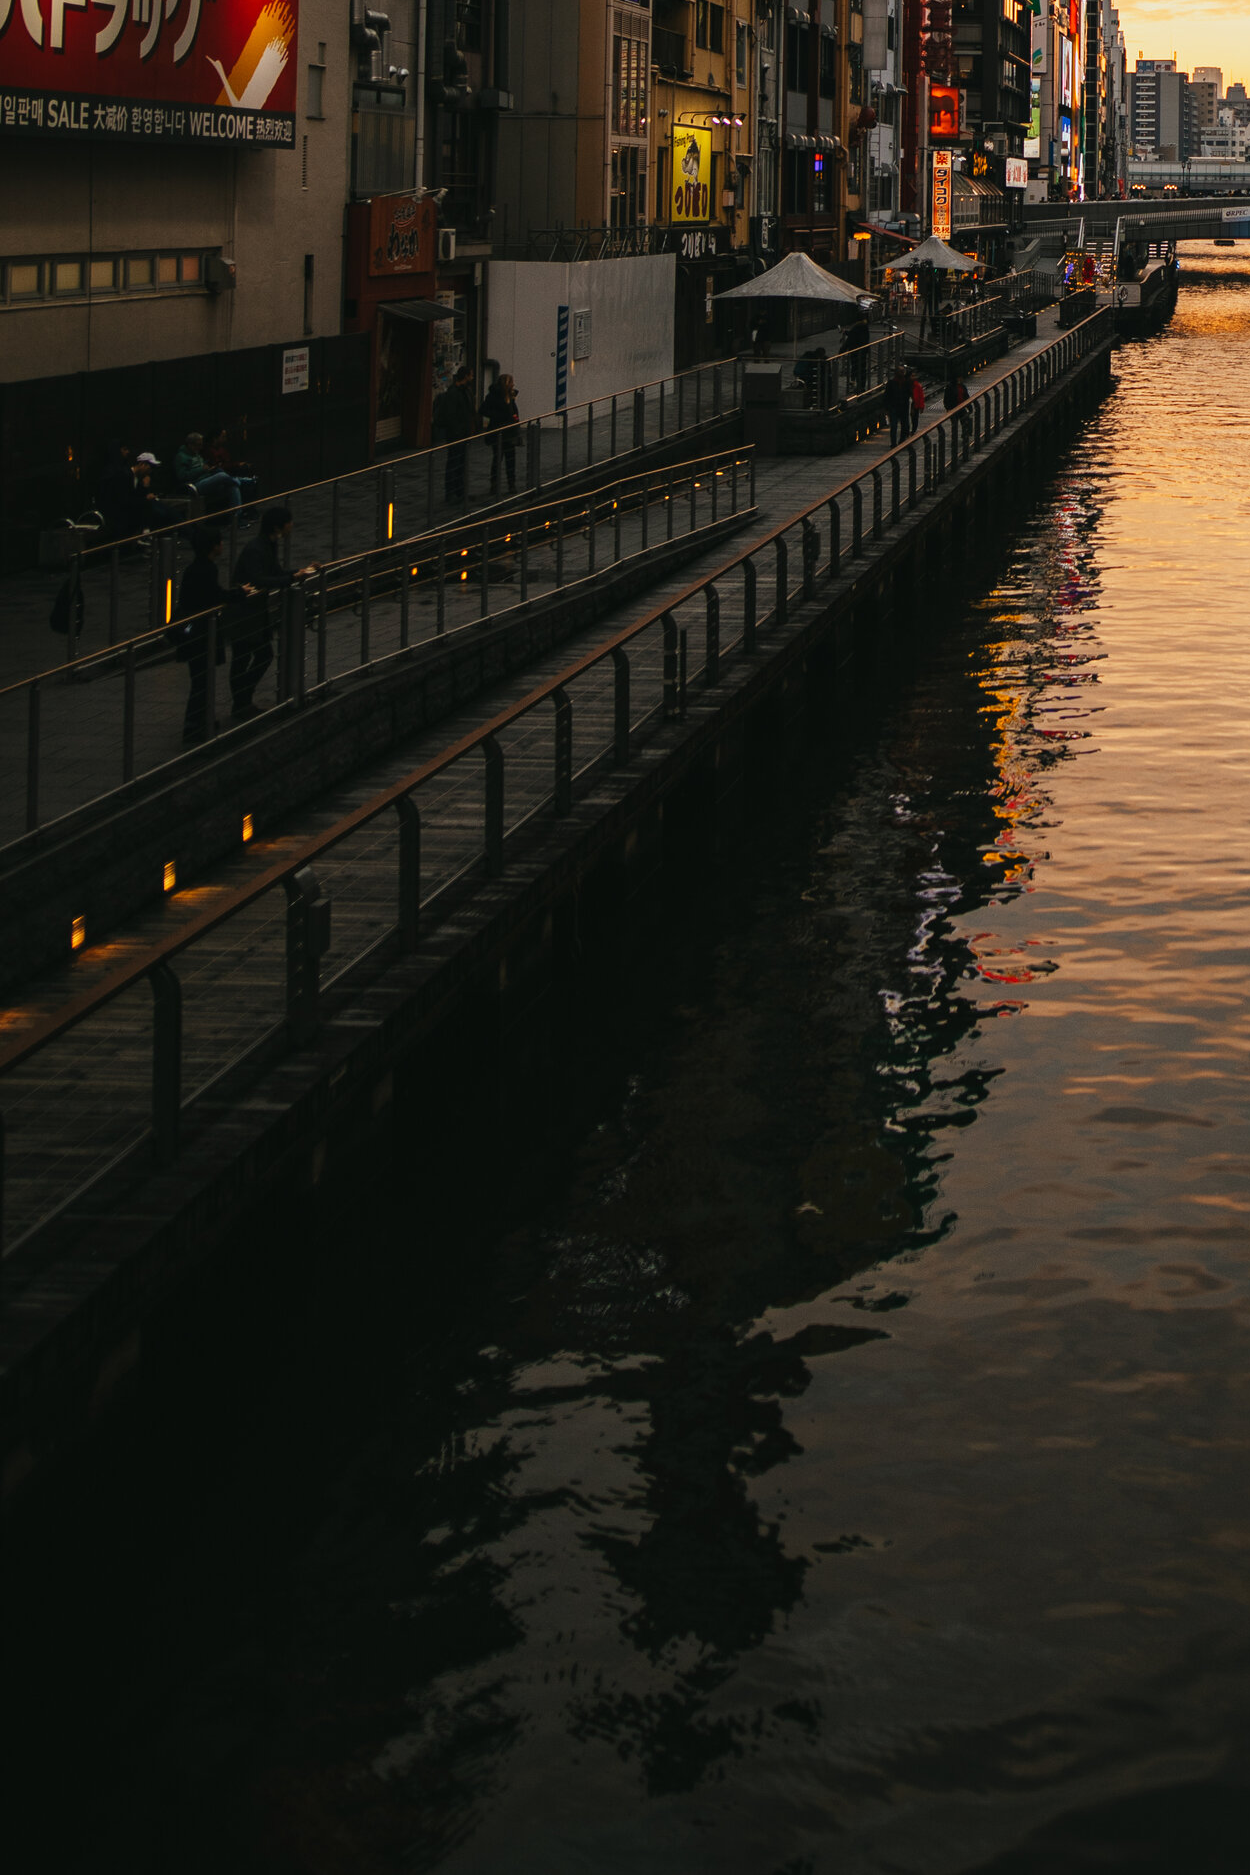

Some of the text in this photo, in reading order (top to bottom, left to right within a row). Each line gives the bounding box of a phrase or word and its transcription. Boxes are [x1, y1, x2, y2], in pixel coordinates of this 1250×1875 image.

[0, 95, 44, 127] 일판매
[47, 99, 89, 129] SALE
[131, 108, 186, 136] 환영합니다
[189, 111, 254, 139] WELCOME
